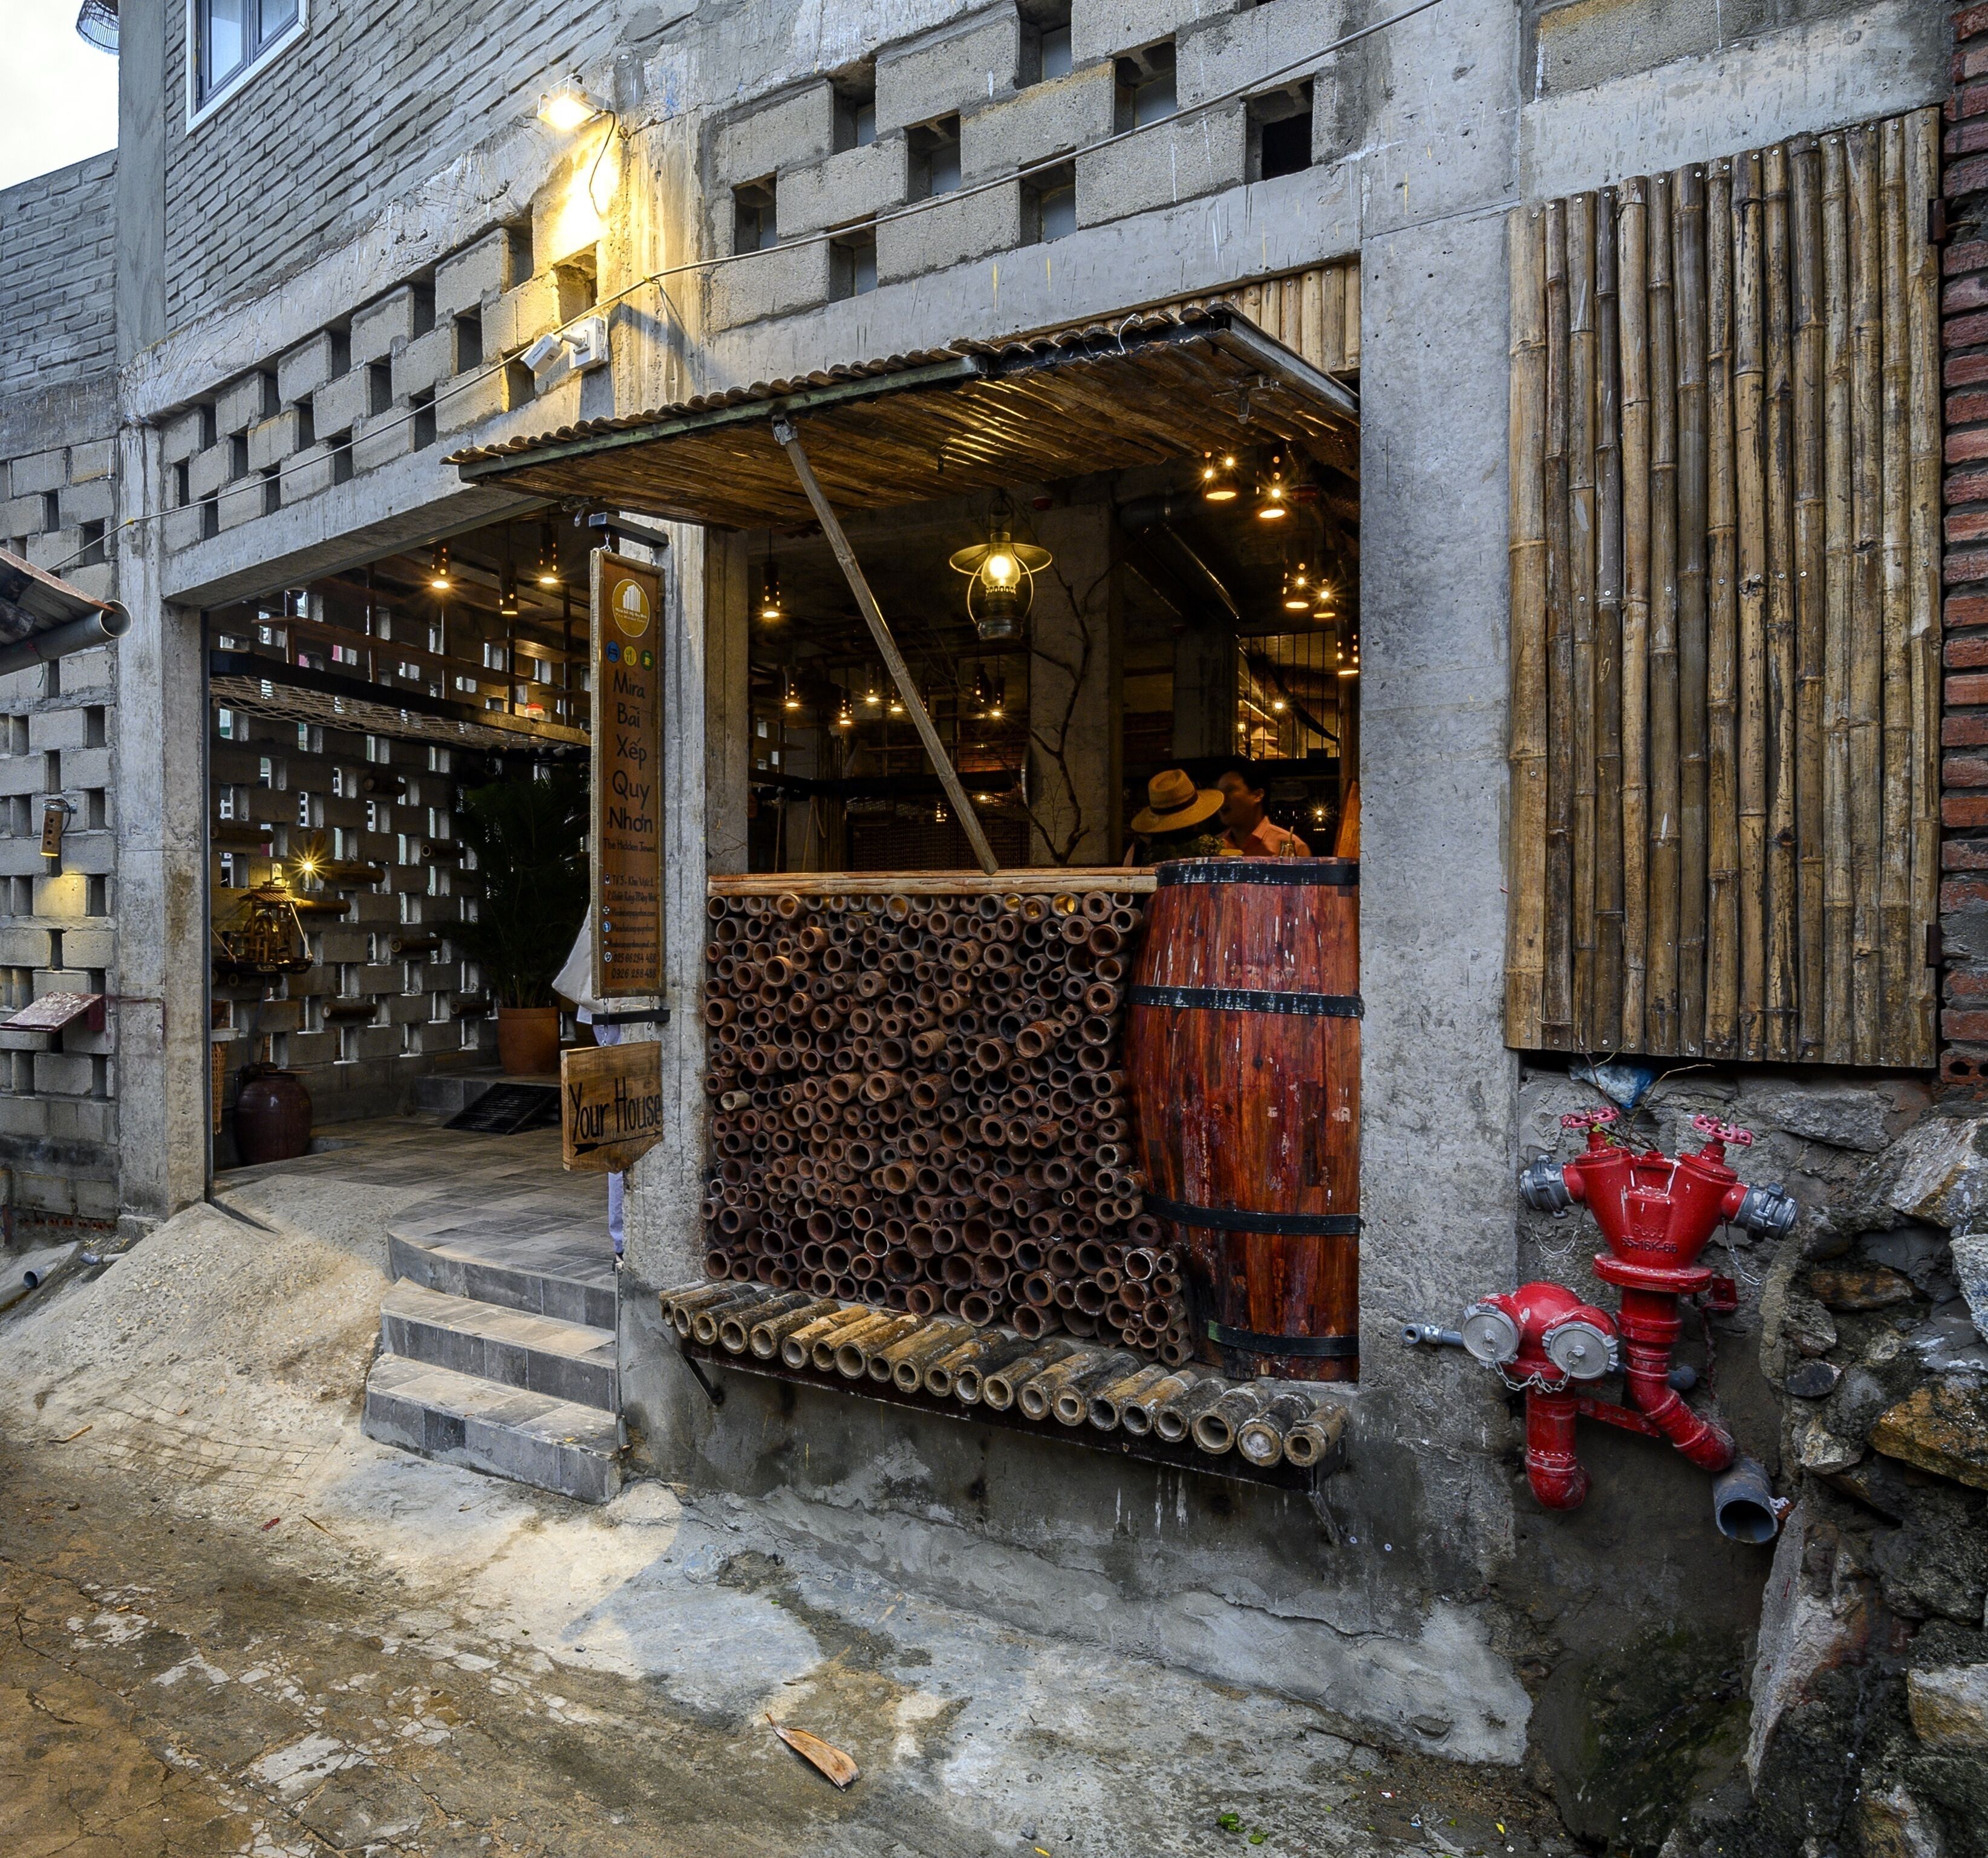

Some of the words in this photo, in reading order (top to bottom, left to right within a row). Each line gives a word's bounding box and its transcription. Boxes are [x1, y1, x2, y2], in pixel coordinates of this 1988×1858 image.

[613, 669, 645, 699] Mira
[618, 702, 640, 728] Bãi
[616, 734, 647, 771] Xếp
[612, 770, 650, 810] Quy
[603, 838, 616, 850] The
[569, 1082, 610, 1142] Your
[614, 1077, 662, 1133] House
